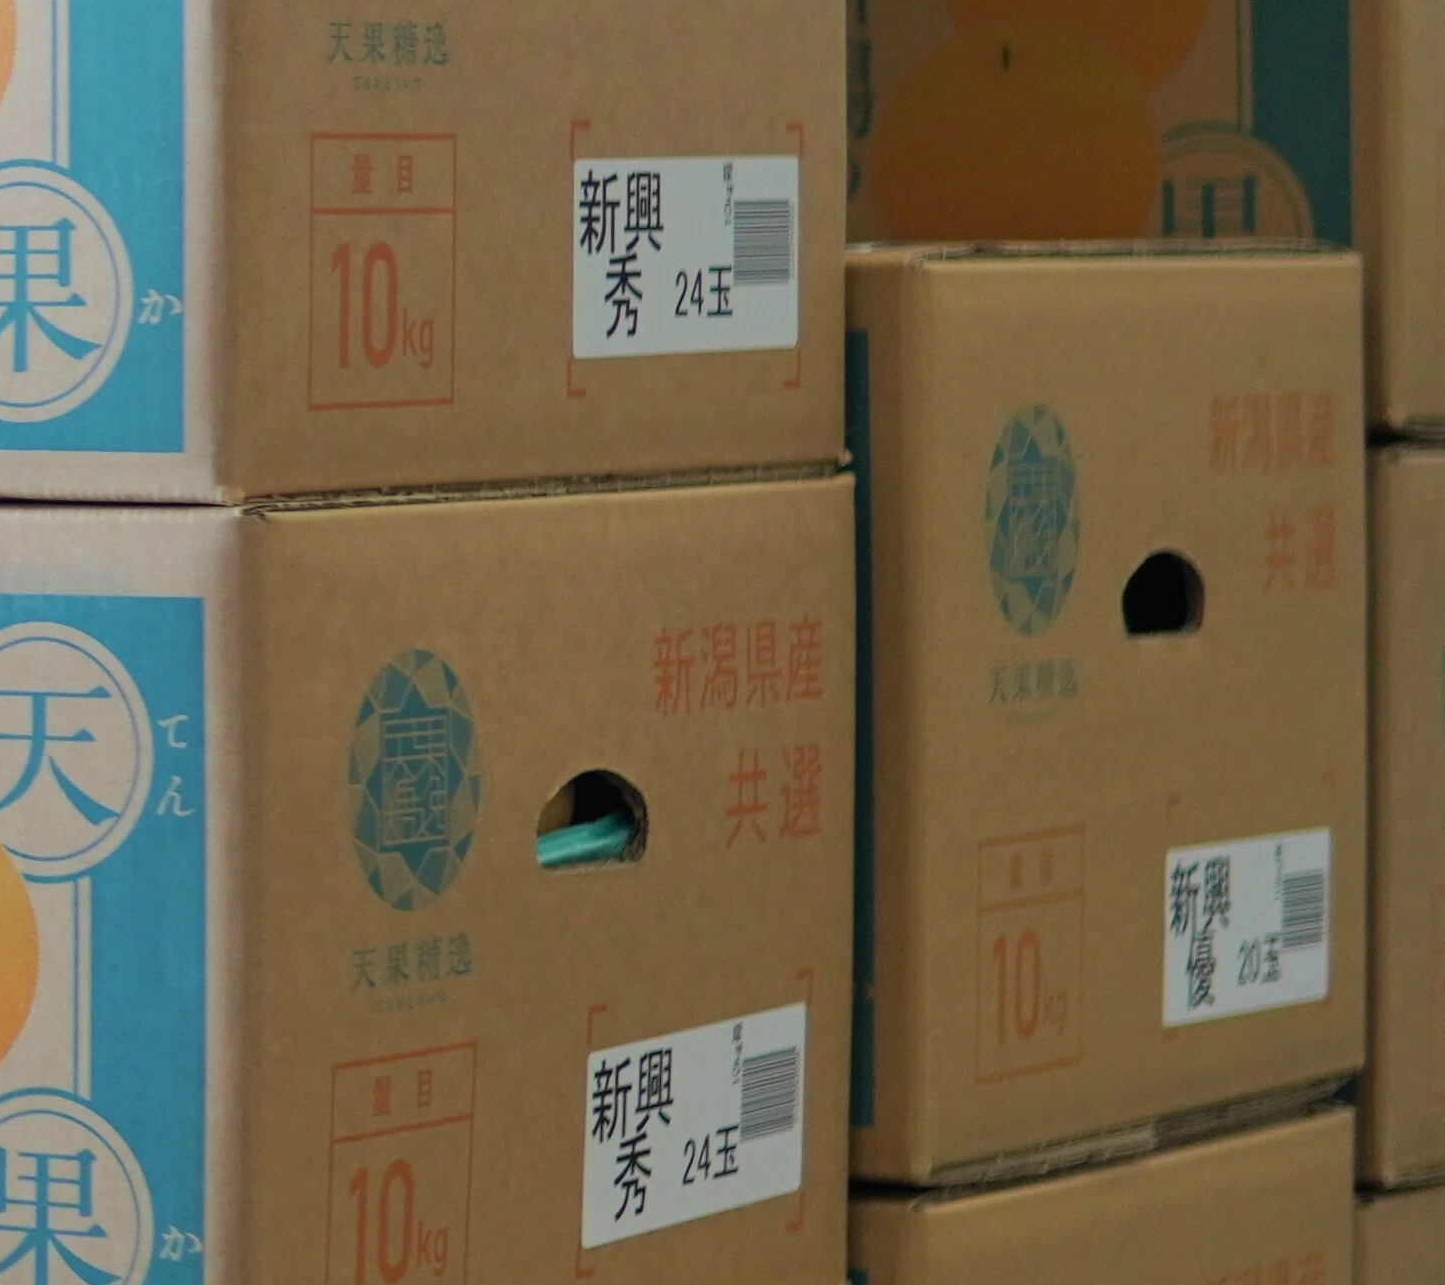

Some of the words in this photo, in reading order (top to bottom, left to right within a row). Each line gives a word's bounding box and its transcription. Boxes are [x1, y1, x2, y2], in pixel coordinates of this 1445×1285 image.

[579, 169, 663, 254] 新興
[139, 289, 184, 325] か
[330, 241, 434, 369] 10kg
[605, 253, 642, 338] 秀
[675, 265, 733, 318] 24玉
[653, 613, 824, 716] 新潟県産
[157, 714, 195, 818] てん
[726, 743, 823, 848] 共選
[1169, 856, 1232, 930] 新興
[592, 1047, 674, 1143] 新興
[613, 1130, 651, 1221] 秀
[682, 1124, 739, 1186] 24玉
[160, 1225, 204, 1261] か
